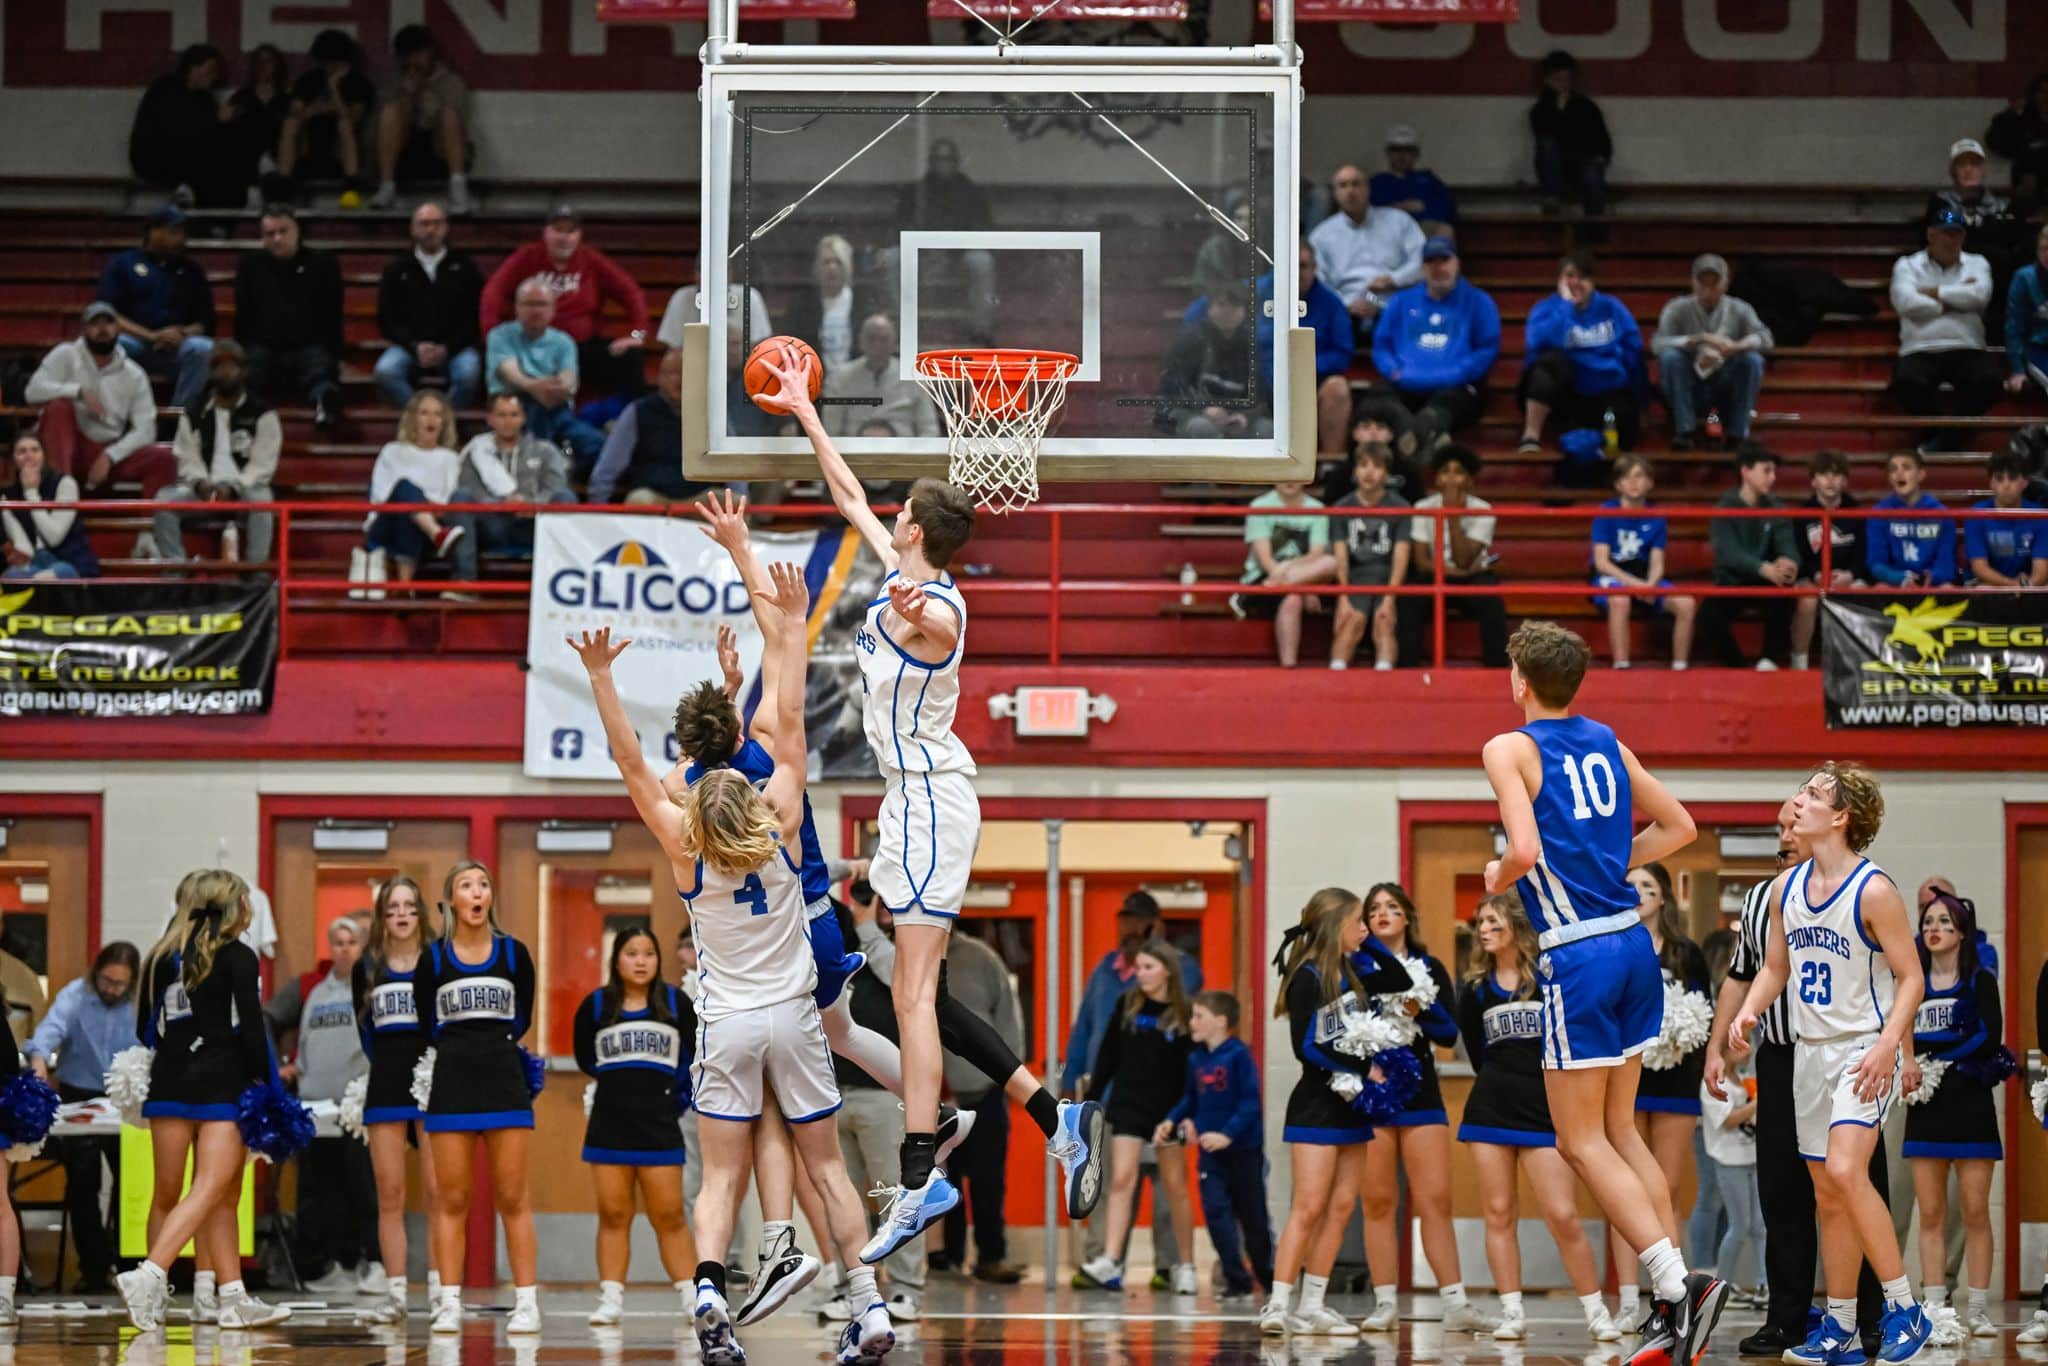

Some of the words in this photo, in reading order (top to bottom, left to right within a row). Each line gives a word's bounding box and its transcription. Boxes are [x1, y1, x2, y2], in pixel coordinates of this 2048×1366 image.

[7, 612, 243, 636] PEGASUS
[1944, 626, 2048, 648] PEG
[72, 666, 240, 681] NETWORK
[1862, 680, 1999, 695] SPORTS
[0, 688, 262, 717] gasussportsky.com
[1562, 752, 1616, 820] 10
[733, 872, 768, 916] 4
[1785, 926, 1850, 960] PIONEERS
[1800, 961, 1831, 1005] 23
